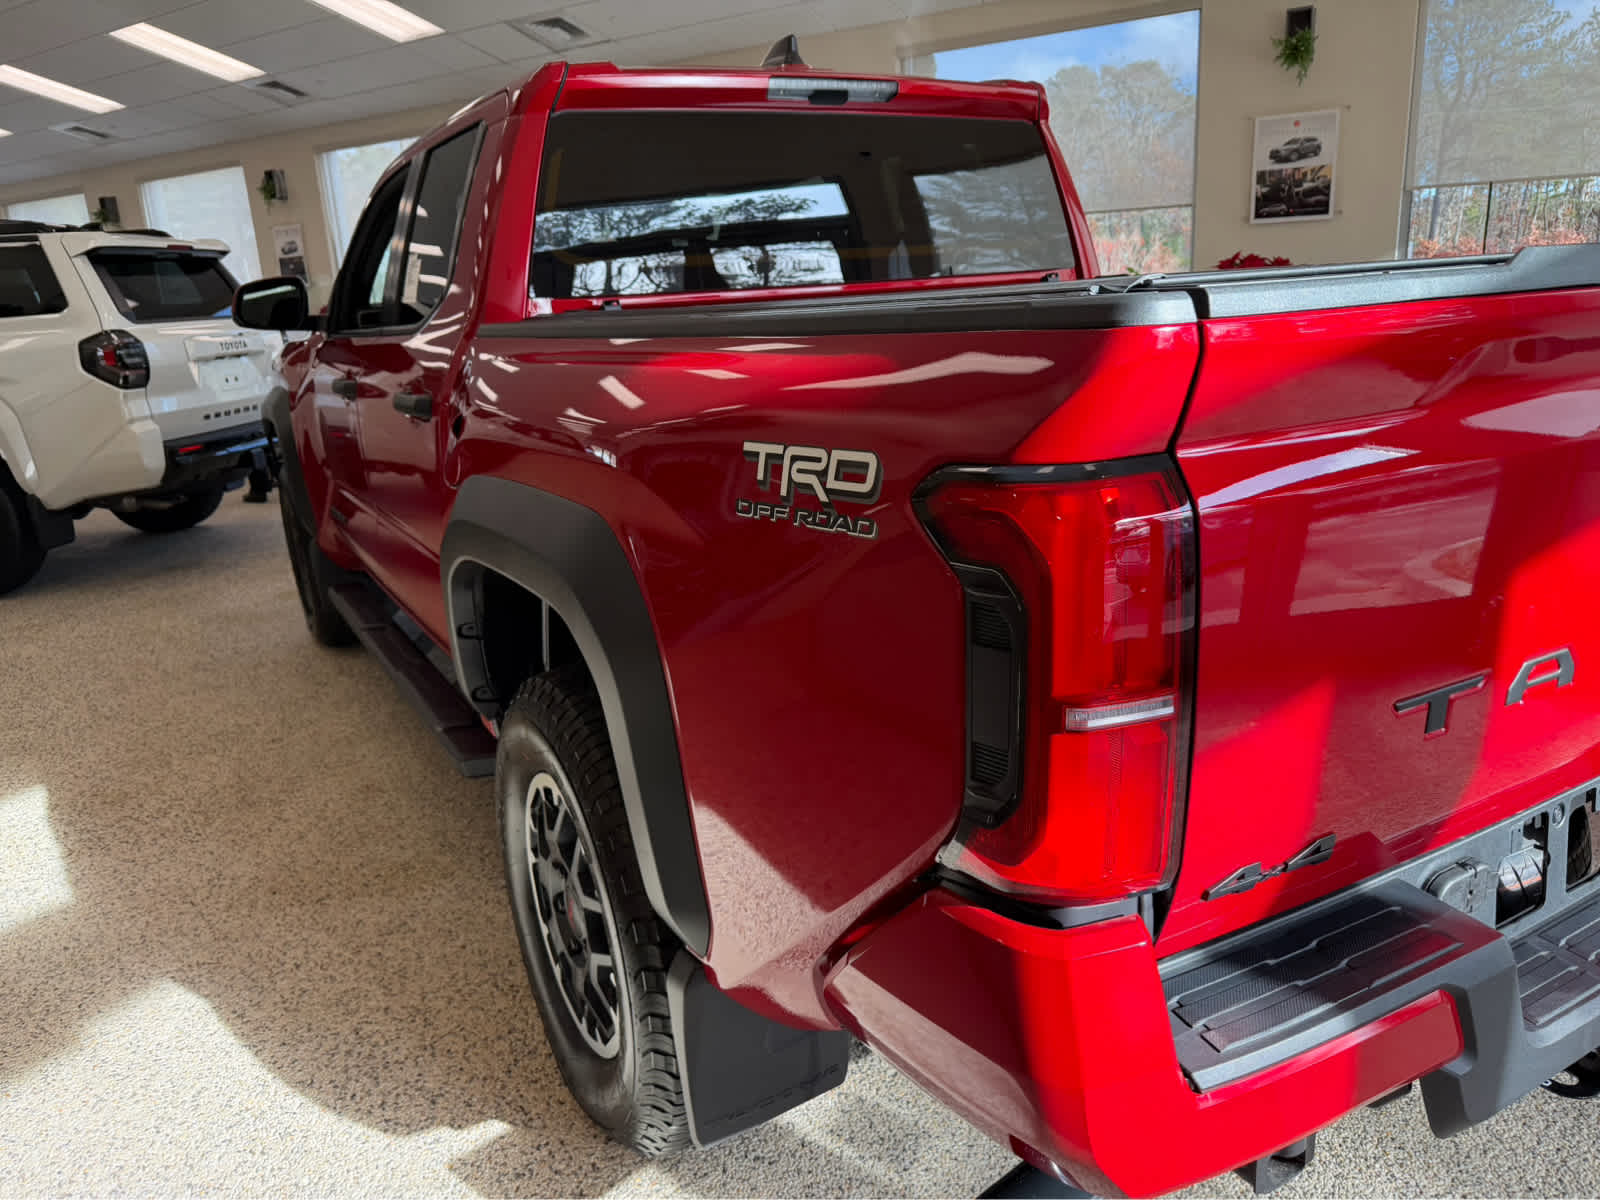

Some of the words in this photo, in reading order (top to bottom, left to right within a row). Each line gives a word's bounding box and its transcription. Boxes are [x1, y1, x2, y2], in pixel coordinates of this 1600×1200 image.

[219, 341, 249, 351] TOYOTA
[742, 440, 882, 506] TRD
[735, 498, 790, 522] OFF
[793, 509, 878, 539] ROAD
